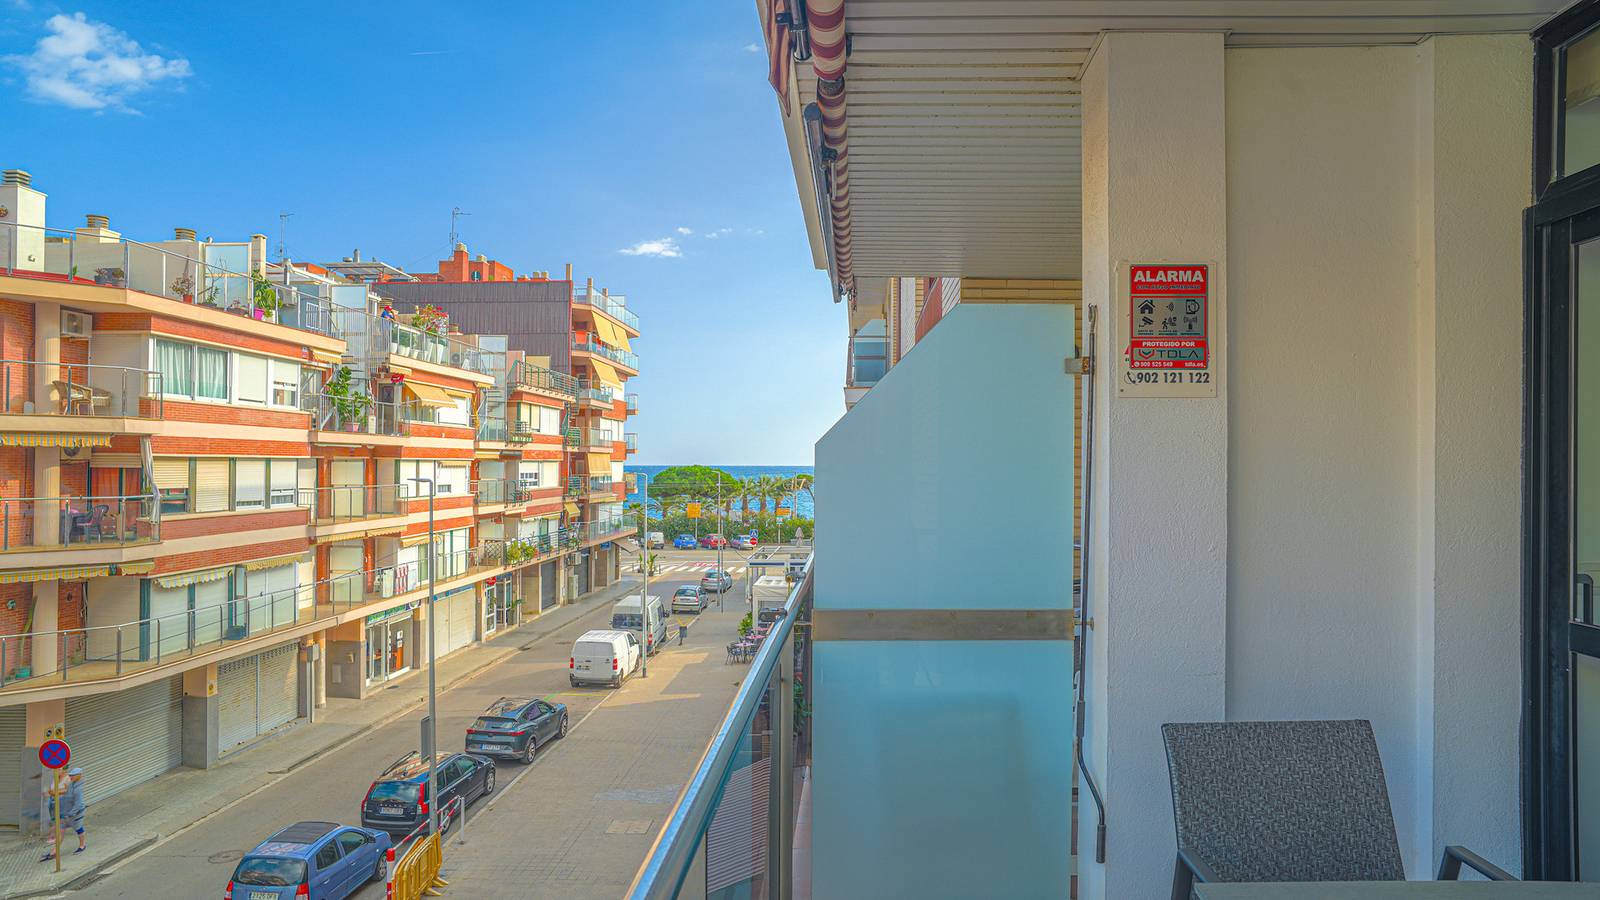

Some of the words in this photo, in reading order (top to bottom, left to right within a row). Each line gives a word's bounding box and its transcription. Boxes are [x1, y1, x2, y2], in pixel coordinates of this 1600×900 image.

[1134, 270, 1204, 282] ALARMA
[1137, 372, 1159, 384] 902
[1163, 372, 1183, 384] 121
[1189, 372, 1210, 384] 122
